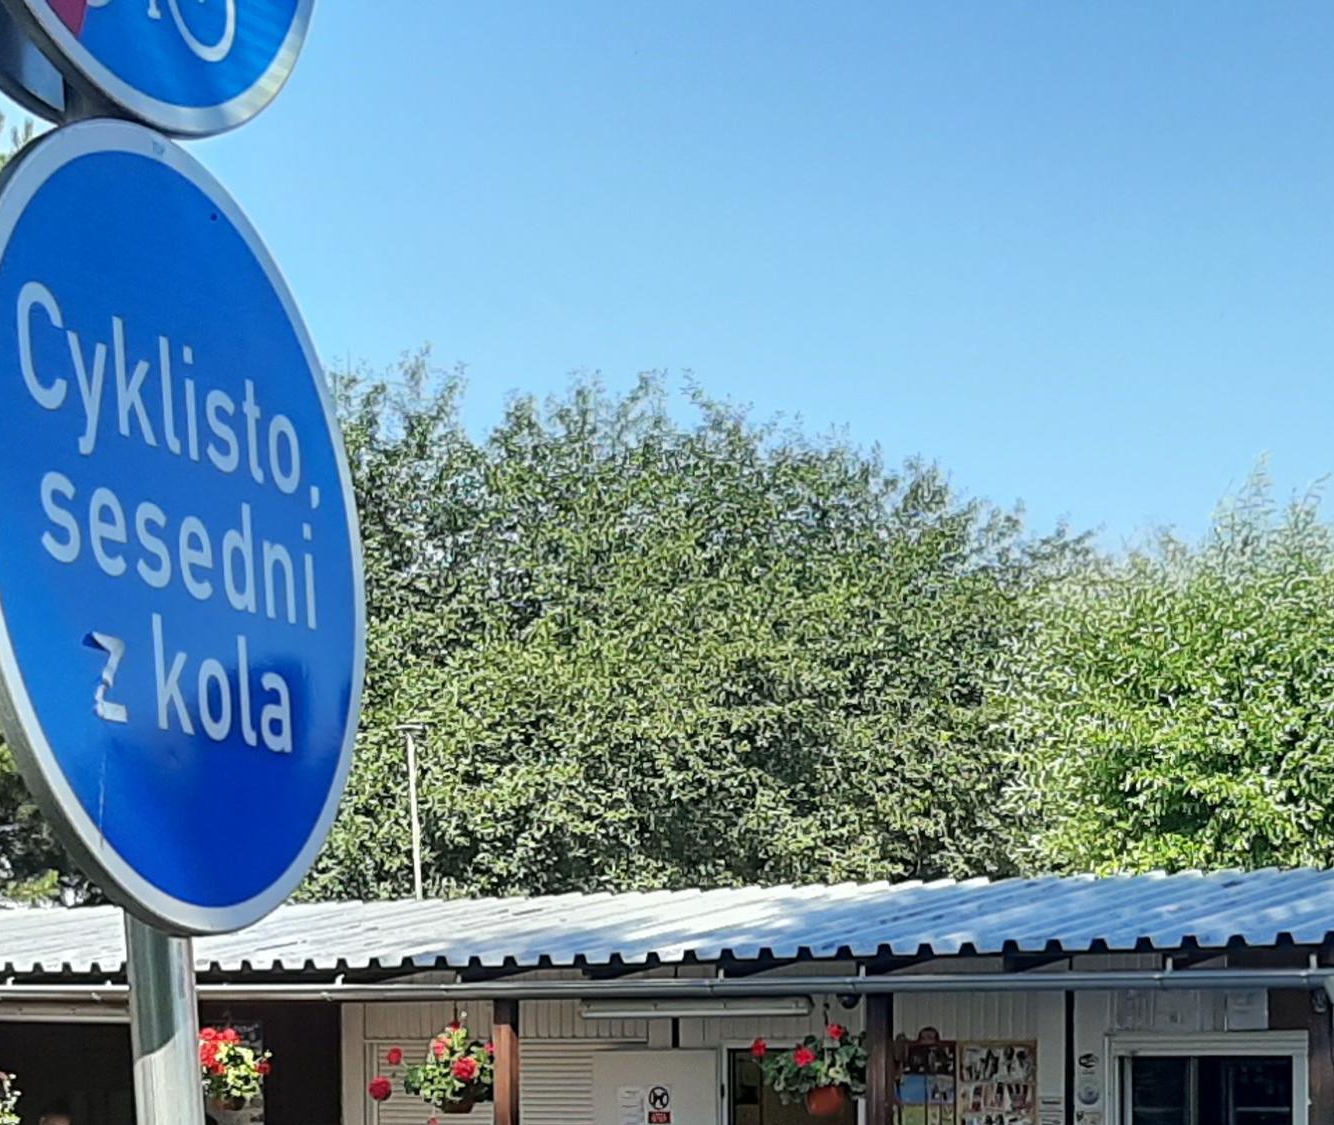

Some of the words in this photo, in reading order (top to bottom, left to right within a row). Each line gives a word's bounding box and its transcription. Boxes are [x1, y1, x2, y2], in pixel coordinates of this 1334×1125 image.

[17, 281, 322, 509] Cyklisto,
[41, 472, 318, 630] sesedni
[83, 631, 127, 723] z
[152, 613, 293, 754] kola
